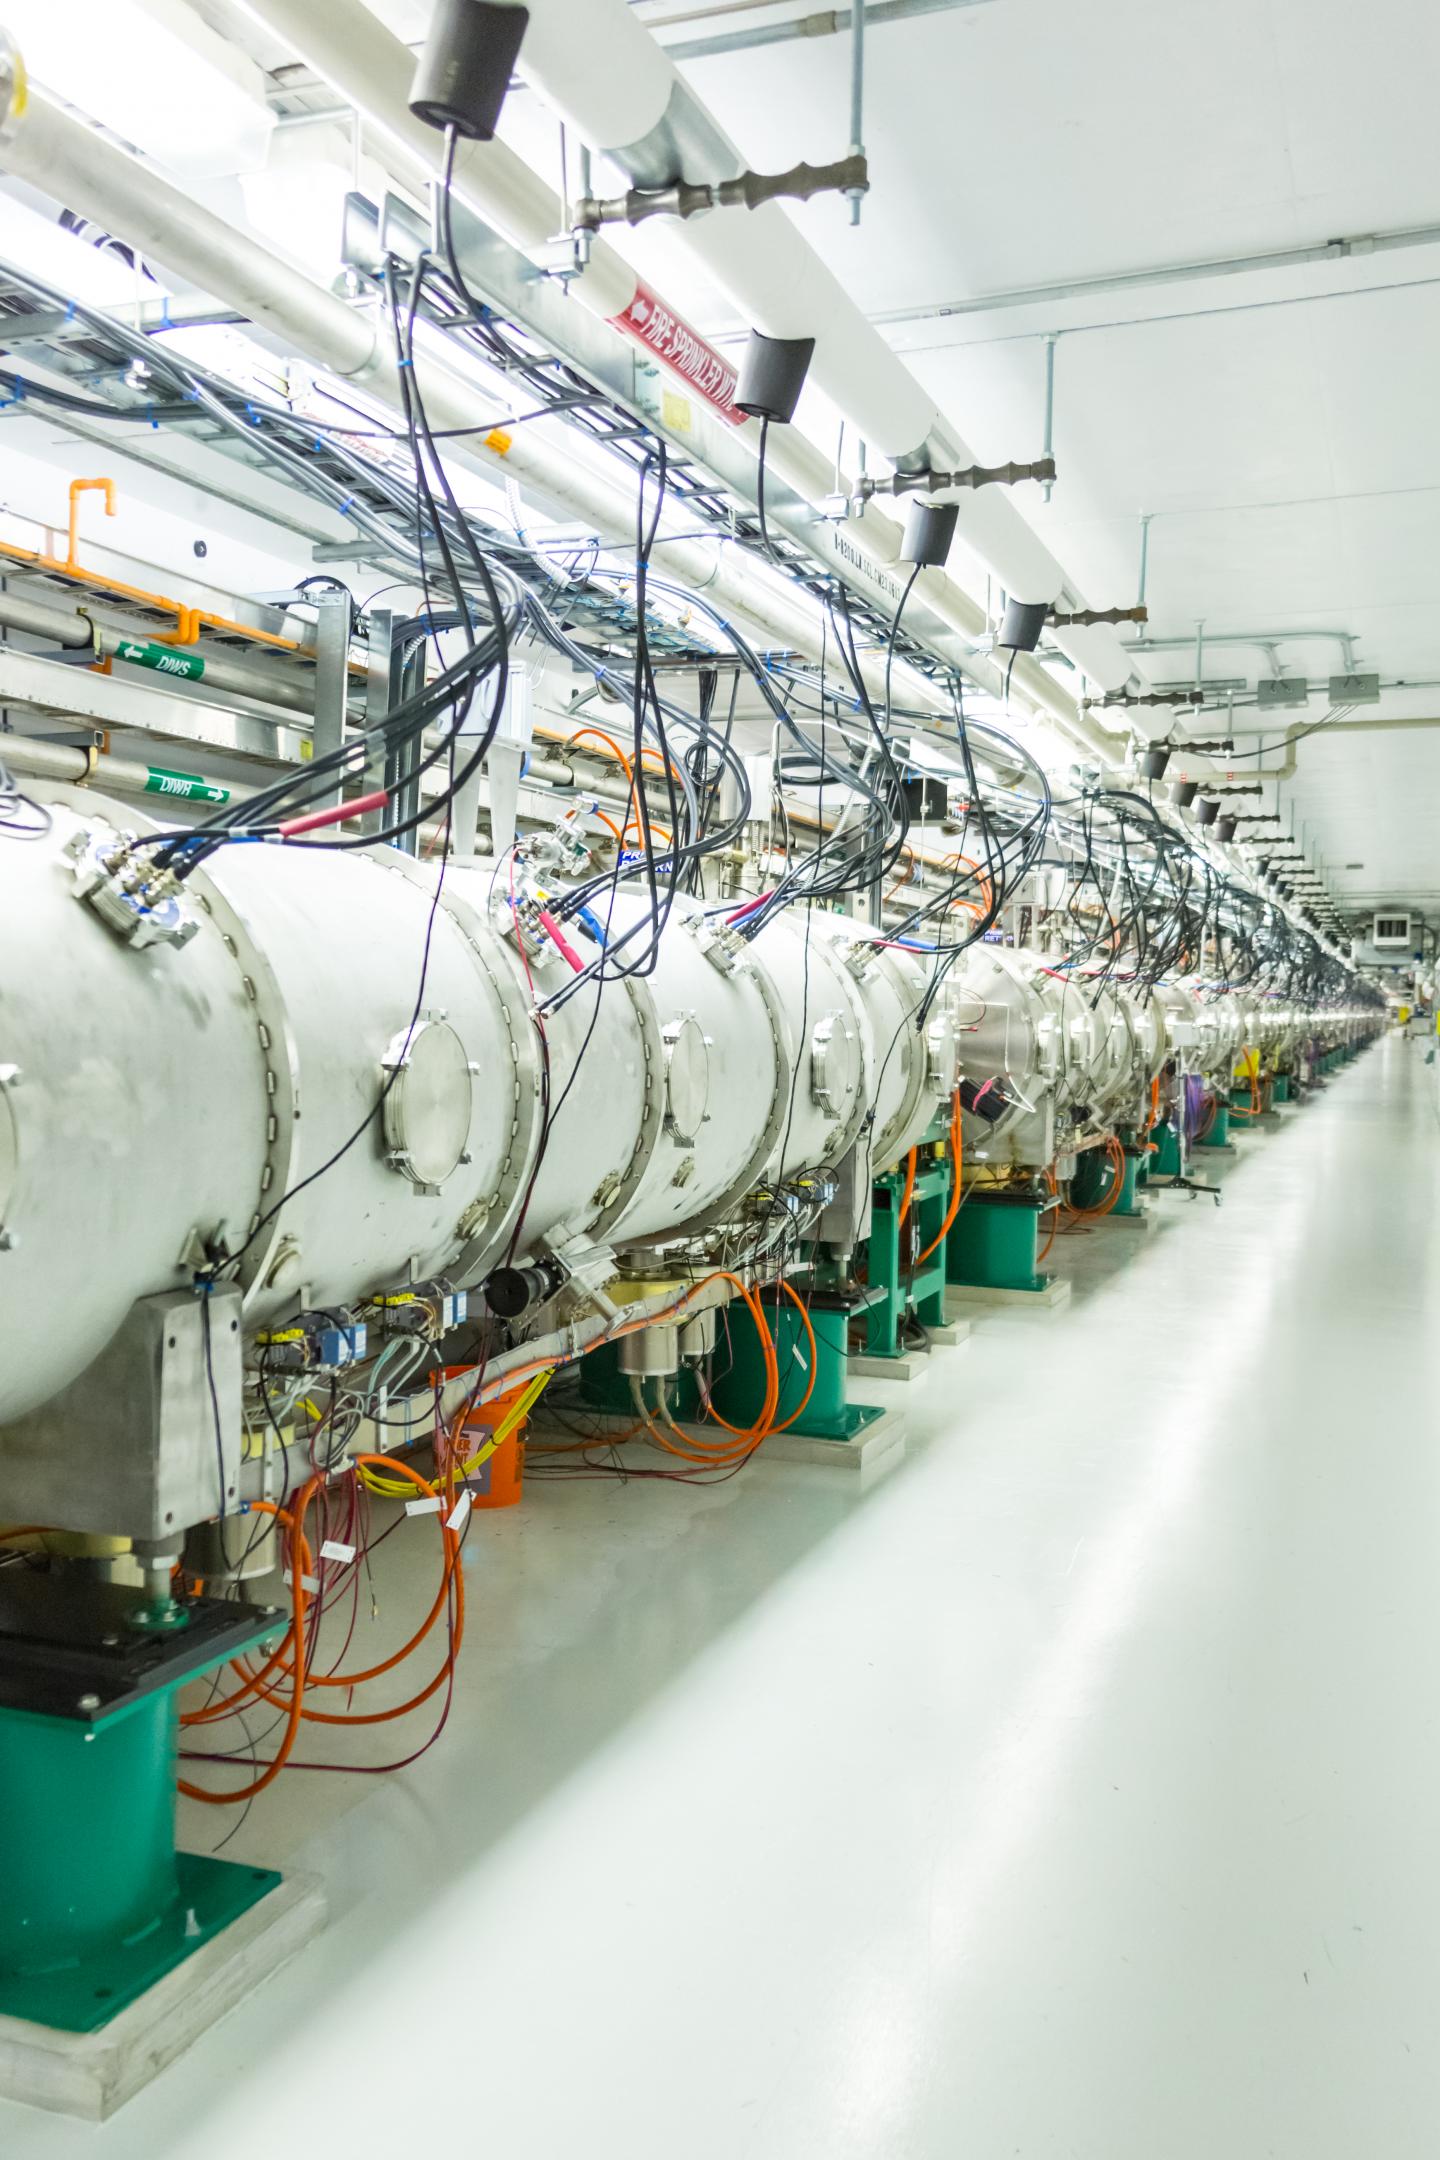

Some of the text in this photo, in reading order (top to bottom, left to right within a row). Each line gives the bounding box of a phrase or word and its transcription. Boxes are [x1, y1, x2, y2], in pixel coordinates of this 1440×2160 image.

[640, 303, 675, 348] FIRE
[664, 326, 722, 393] SPRINKLER
[155, 655, 191, 676] DIWS
[160, 777, 192, 796] DIWR
